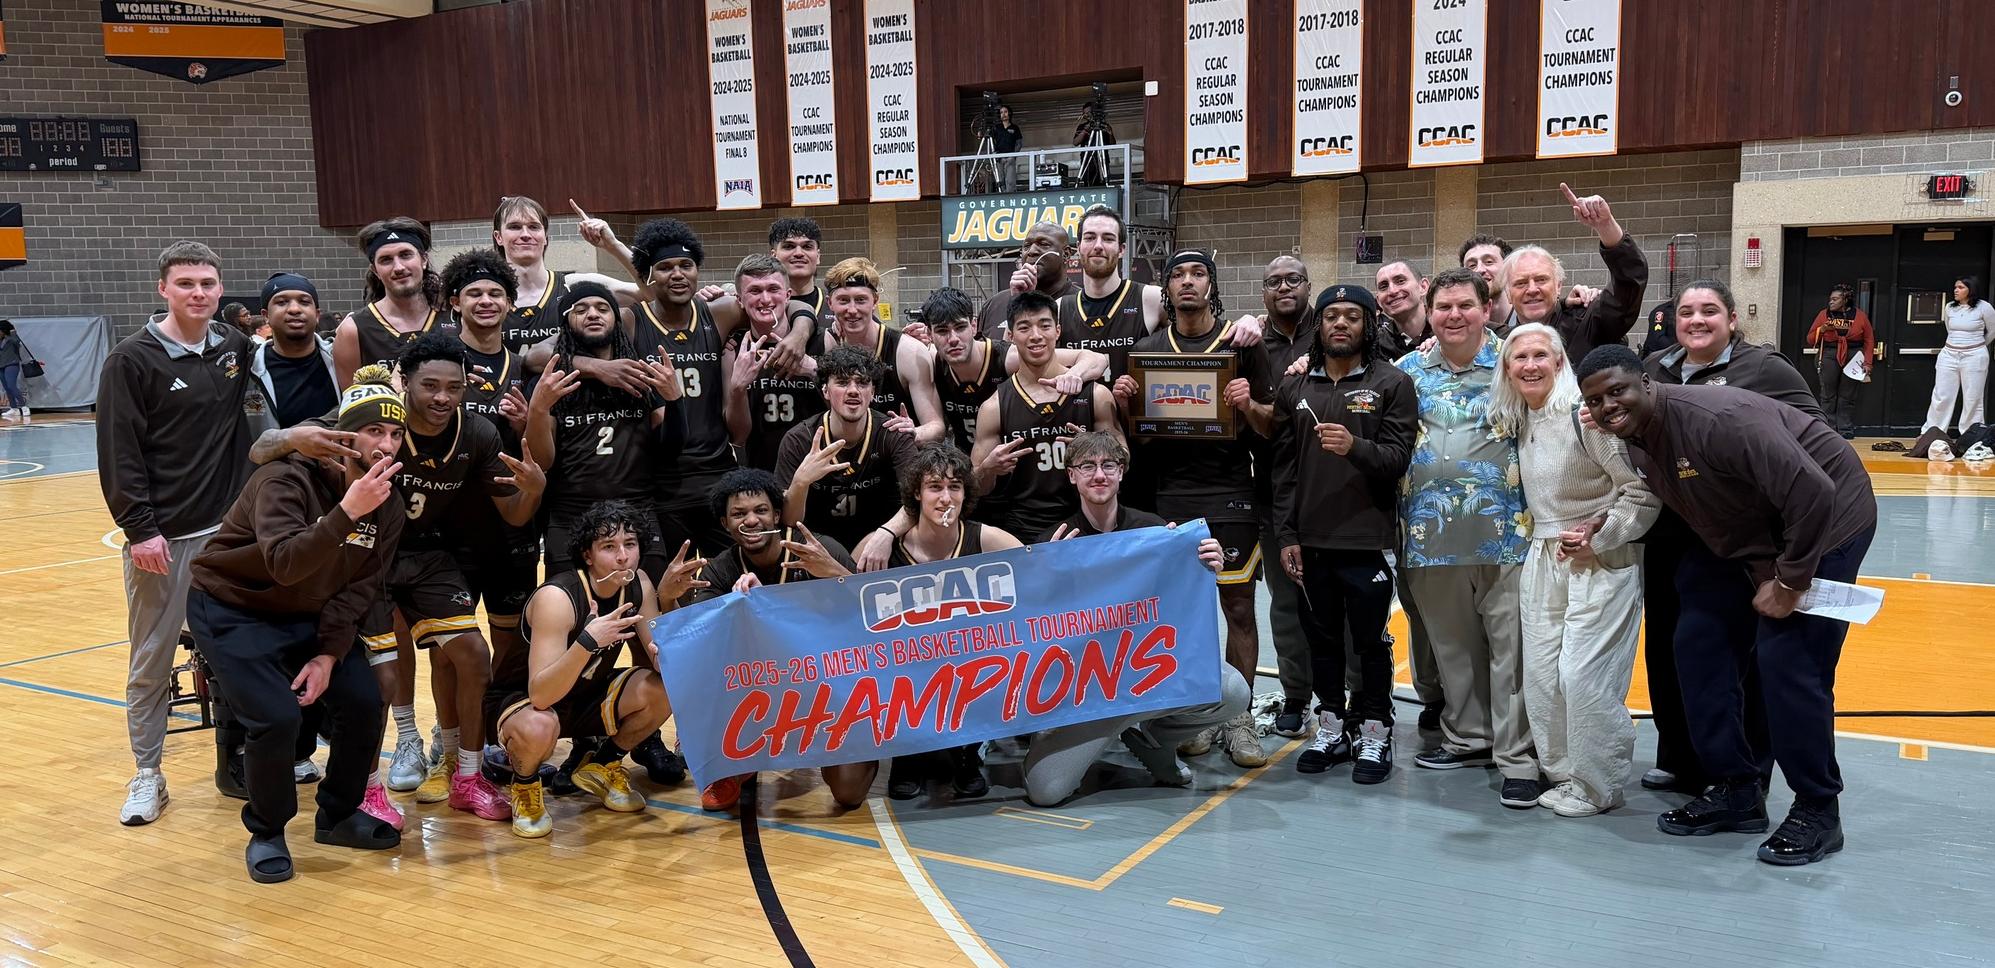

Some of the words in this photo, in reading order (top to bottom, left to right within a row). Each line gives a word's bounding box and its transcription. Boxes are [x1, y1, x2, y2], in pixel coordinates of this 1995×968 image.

[115, 3, 182, 15] WOMEN'S
[710, 7, 748, 21] JAGUARS
[211, 16, 262, 24] APPEARANCES
[872, 14, 908, 28] WOMEN'S
[1298, 9, 1359, 32] 2017-2018
[791, 24, 825, 38] WOMEN'S
[1188, 18, 1245, 40] 2017-2018
[1435, 29, 1463, 45] CCAC
[1565, 27, 1595, 44] CCAC
[714, 34, 746, 48] WOMEN'S
[868, 30, 913, 45] BASKETBALL
[787, 40, 830, 55] BASKETBALL
[711, 49, 752, 63] BASKETBALL
[1204, 56, 1228, 71] CCAC
[1315, 55, 1341, 70] CCAC
[1425, 48, 1473, 65] REGULAR
[1543, 48, 1616, 67] TOURNAMENT
[869, 62, 914, 79] 2024-2025
[1427, 67, 1469, 84] SEASON
[713, 79, 753, 94] 2024-2025
[789, 71, 831, 87] 2024-2025
[1196, 74, 1237, 90] REGULAR
[1297, 73, 1359, 92] TOURNAMENT
[1544, 70, 1613, 89] CHAMPIONS
[883, 94, 902, 107] CCAC
[1199, 92, 1234, 107] SEASON
[1416, 86, 1480, 104] CHAMPIONS
[1298, 95, 1357, 112] CHAMPIONS
[719, 113, 750, 126] NATIONAL
[802, 107, 820, 119] CCAC
[877, 110, 909, 123] REGULAR
[1189, 109, 1244, 126] CHAMPIONS
[0, 123, 17, 133] ome
[100, 123, 130, 134] Guests
[791, 123, 834, 137] TOURNAMENT
[880, 126, 908, 139] SEASON
[1547, 114, 1609, 138] CCAC
[715, 129, 755, 143] TOURNAMENT
[1418, 125, 1476, 147] CCAC
[725, 148, 743, 158] FINAL
[743, 147, 748, 158] 8
[792, 140, 834, 153] CHAMPIONS
[873, 141, 915, 155] CHAMPIONS
[1300, 135, 1354, 158] CCAC
[49, 157, 78, 167] period
[1192, 145, 1241, 166] CCAC
[796, 173, 833, 190] CCAC
[875, 168, 914, 186] CCAC
[1936, 176, 1962, 193] EXIT
[724, 179, 753, 196] NAIA
[959, 197, 1048, 209] GOVERNORS
[1060, 193, 1107, 204] STATE
[948, 203, 1108, 244] JAGUAR
[1081, 336, 1135, 350] FRANCIS
[760, 378, 815, 390] FRANCIS
[1151, 383, 1212, 405] CCAC
[763, 393, 795, 423] 33
[565, 415, 582, 428] ST
[586, 409, 643, 425] FRANCIS
[596, 426, 614, 455] 2
[1012, 430, 1028, 441] ST
[1036, 442, 1066, 472] 30
[405, 492, 427, 520] 3
[860, 561, 1017, 633] CCAC
[723, 653, 819, 692] 2025-26
[824, 644, 888, 680] MEN'S
[892, 621, 1023, 668] BASKETBALL
[1024, 597, 1161, 643] TOURNAMENT
[721, 625, 1178, 760] CHAMPIONS
